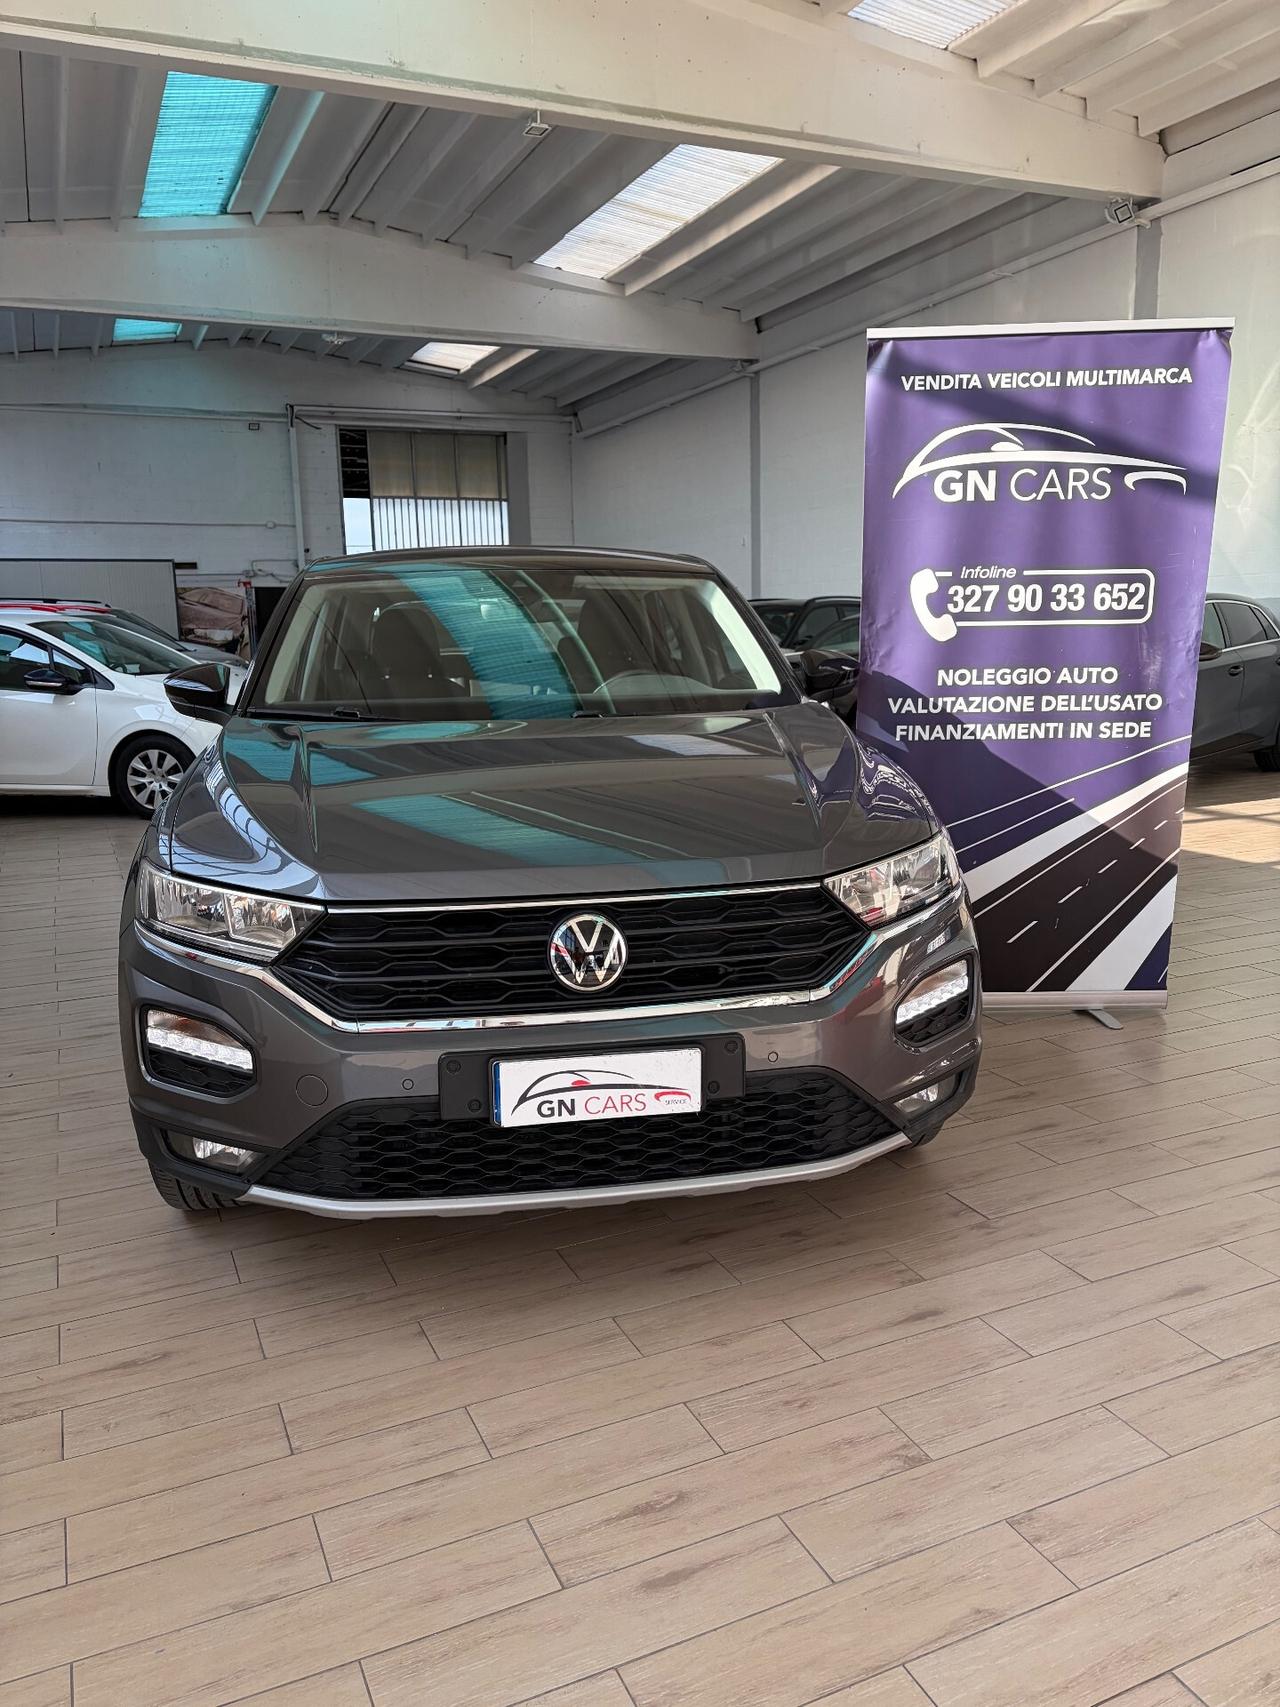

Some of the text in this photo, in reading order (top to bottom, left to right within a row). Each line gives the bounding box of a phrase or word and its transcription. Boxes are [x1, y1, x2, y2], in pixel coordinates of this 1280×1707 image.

[901, 367, 1193, 392] VENDITA VEICOLI MULTIMARCA
[933, 467, 1112, 502] GN CARS
[960, 565, 1017, 580] Infoline
[947, 582, 1145, 613] 327 90 33 652
[937, 667, 1119, 687] NOLEGGIO AUTO
[887, 693, 1163, 715] VALUTAZIONE DELL'USATO
[895, 721, 1152, 741] FINANZIAMENTI IN SEDE
[536, 1093, 647, 1119] GN CARS
